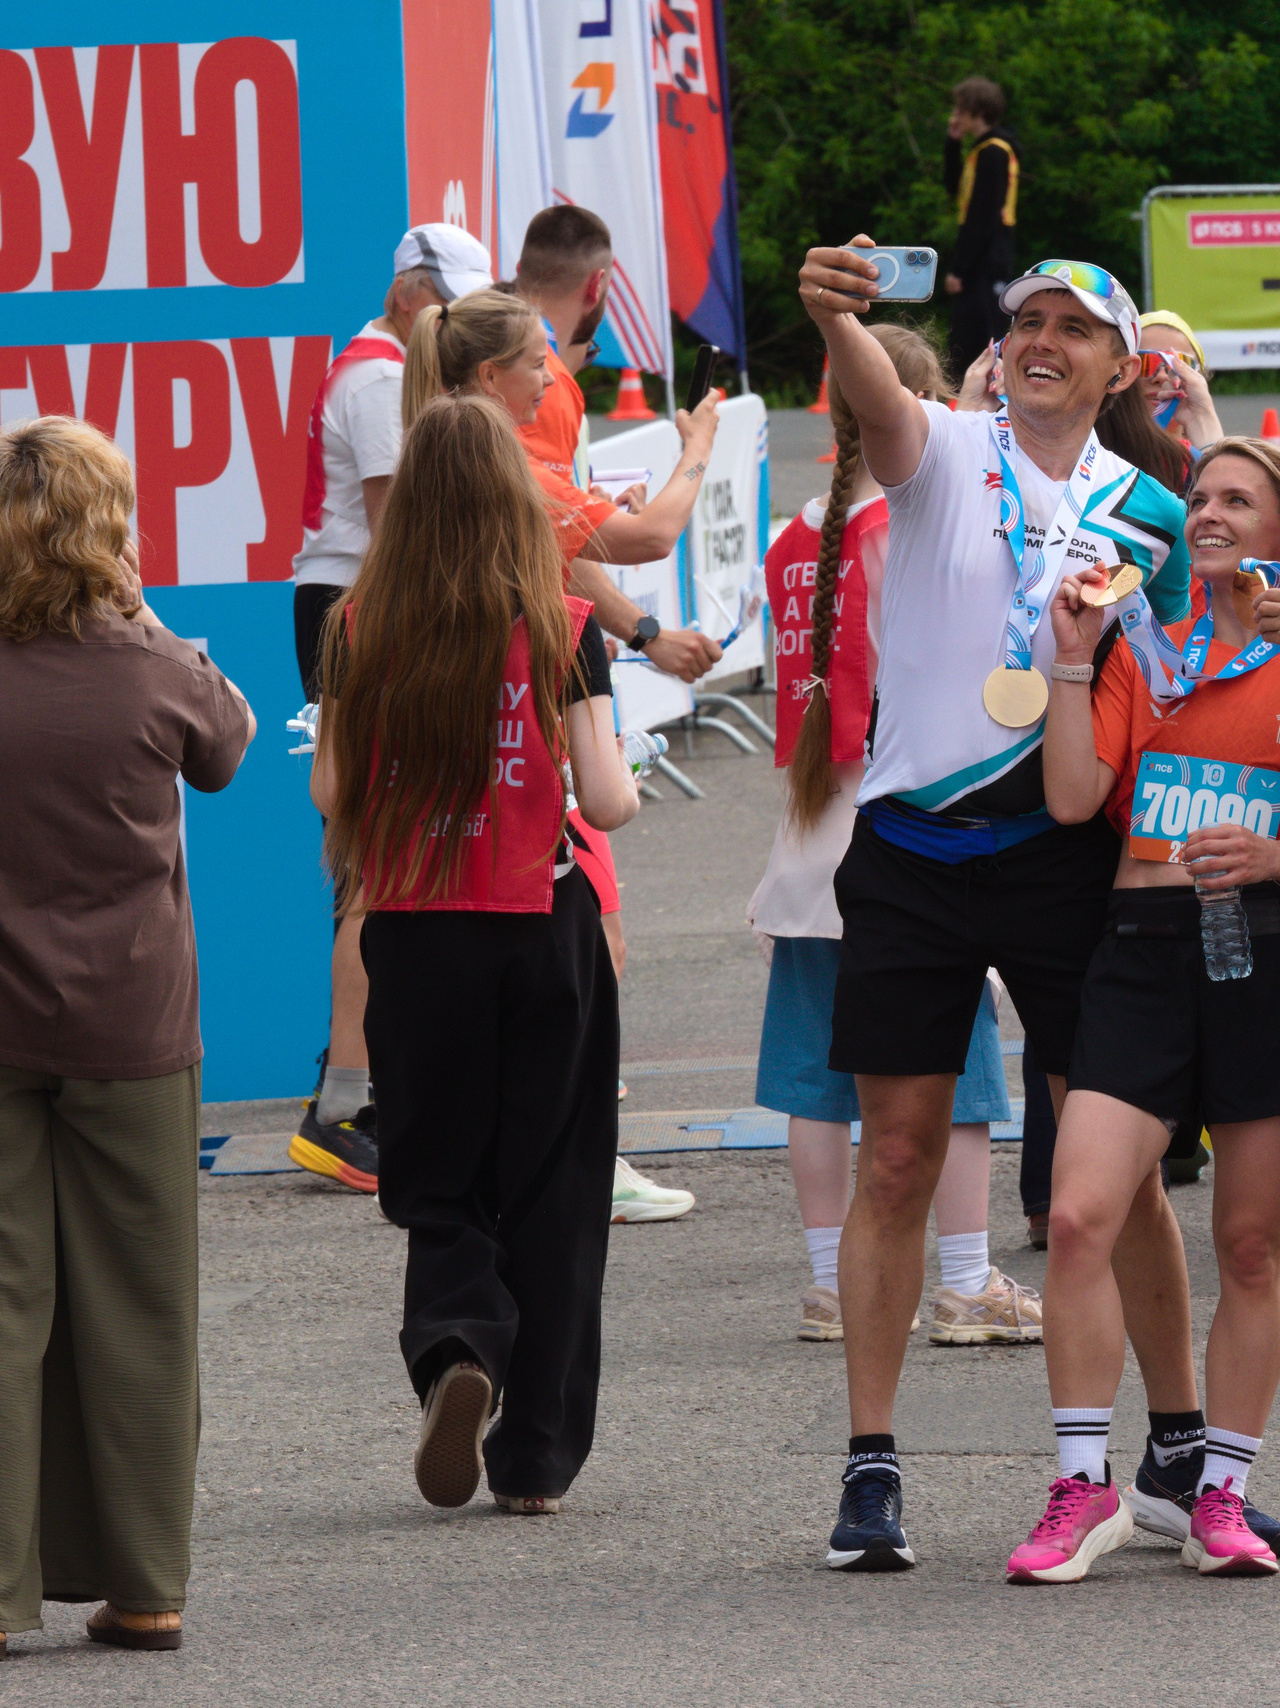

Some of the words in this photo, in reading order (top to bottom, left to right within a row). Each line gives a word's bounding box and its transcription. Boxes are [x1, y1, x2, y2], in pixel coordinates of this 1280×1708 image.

[1211, 221, 1243, 237] ПСБ
[1252, 222, 1261, 236] 5
[998, 430, 1011, 452] ПСБ
[1084, 443, 1097, 468] ПСБ
[1245, 641, 1273, 663] ПСБ
[1155, 763, 1173, 774] ПСБ
